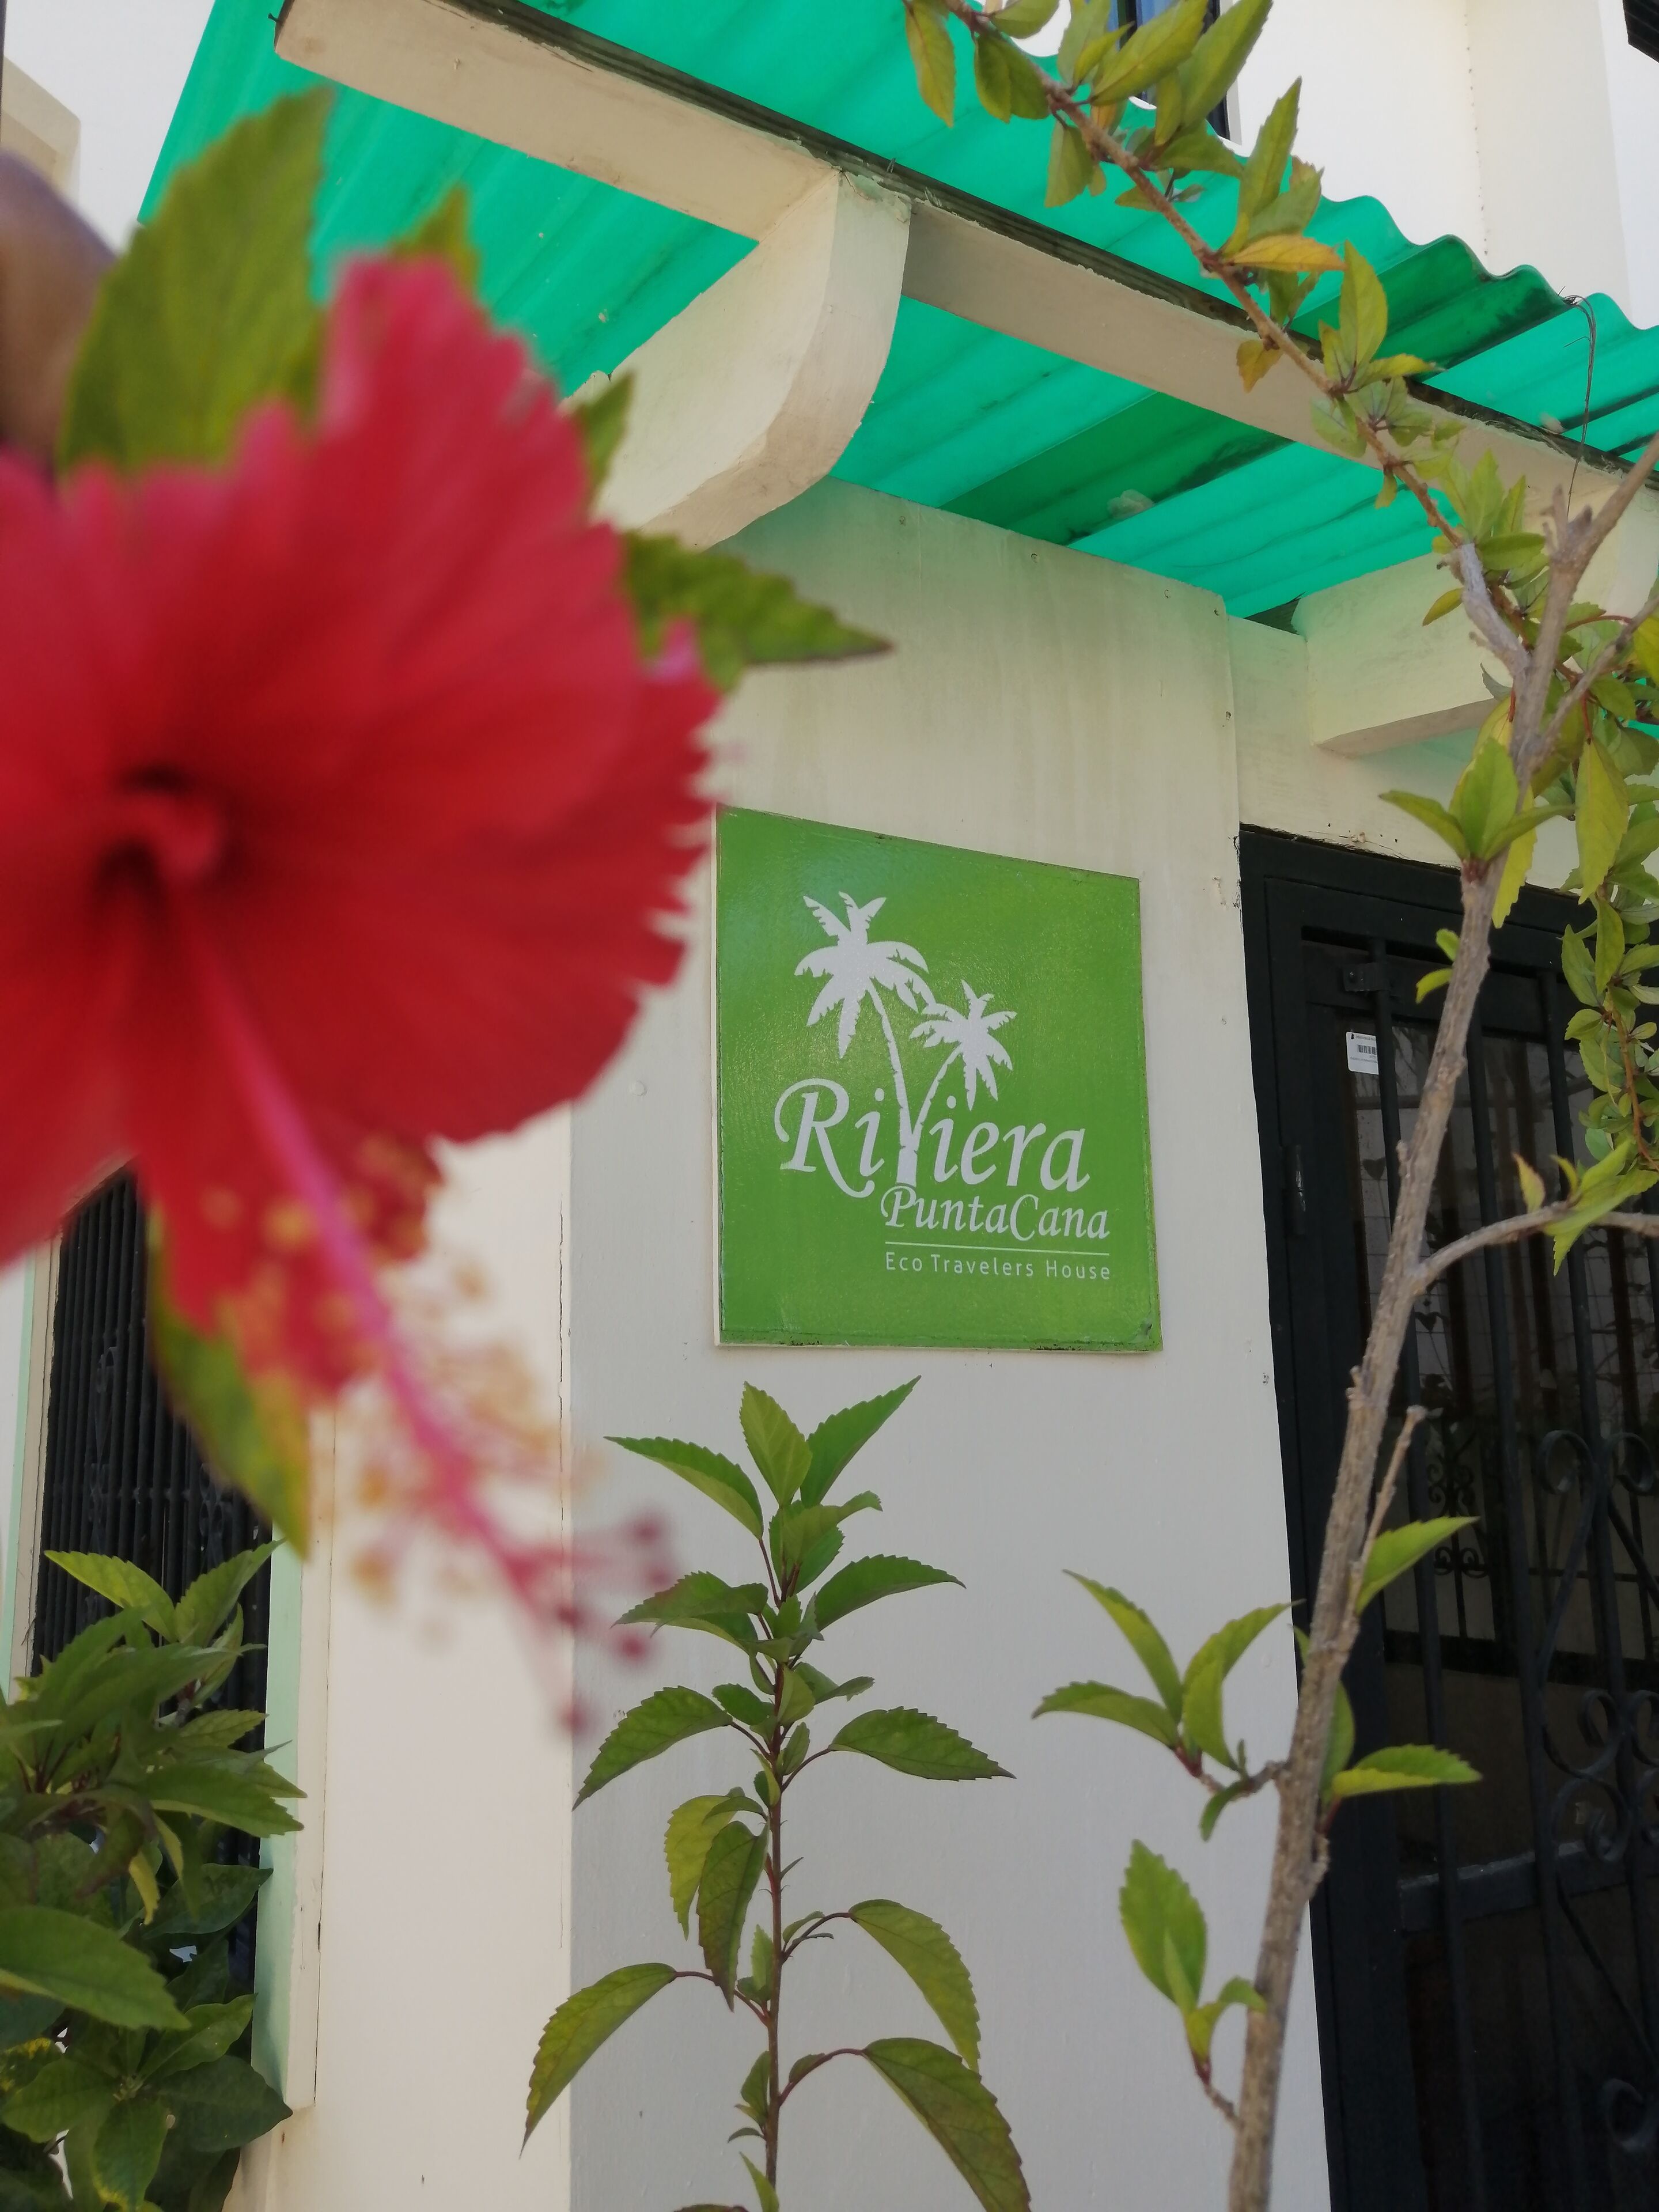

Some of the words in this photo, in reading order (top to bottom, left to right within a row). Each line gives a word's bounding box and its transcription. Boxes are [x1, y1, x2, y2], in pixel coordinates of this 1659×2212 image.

[885, 1252, 923, 1273] Eco
[931, 1255, 1034, 1277] Travelers
[1047, 1260, 1111, 1281] House
